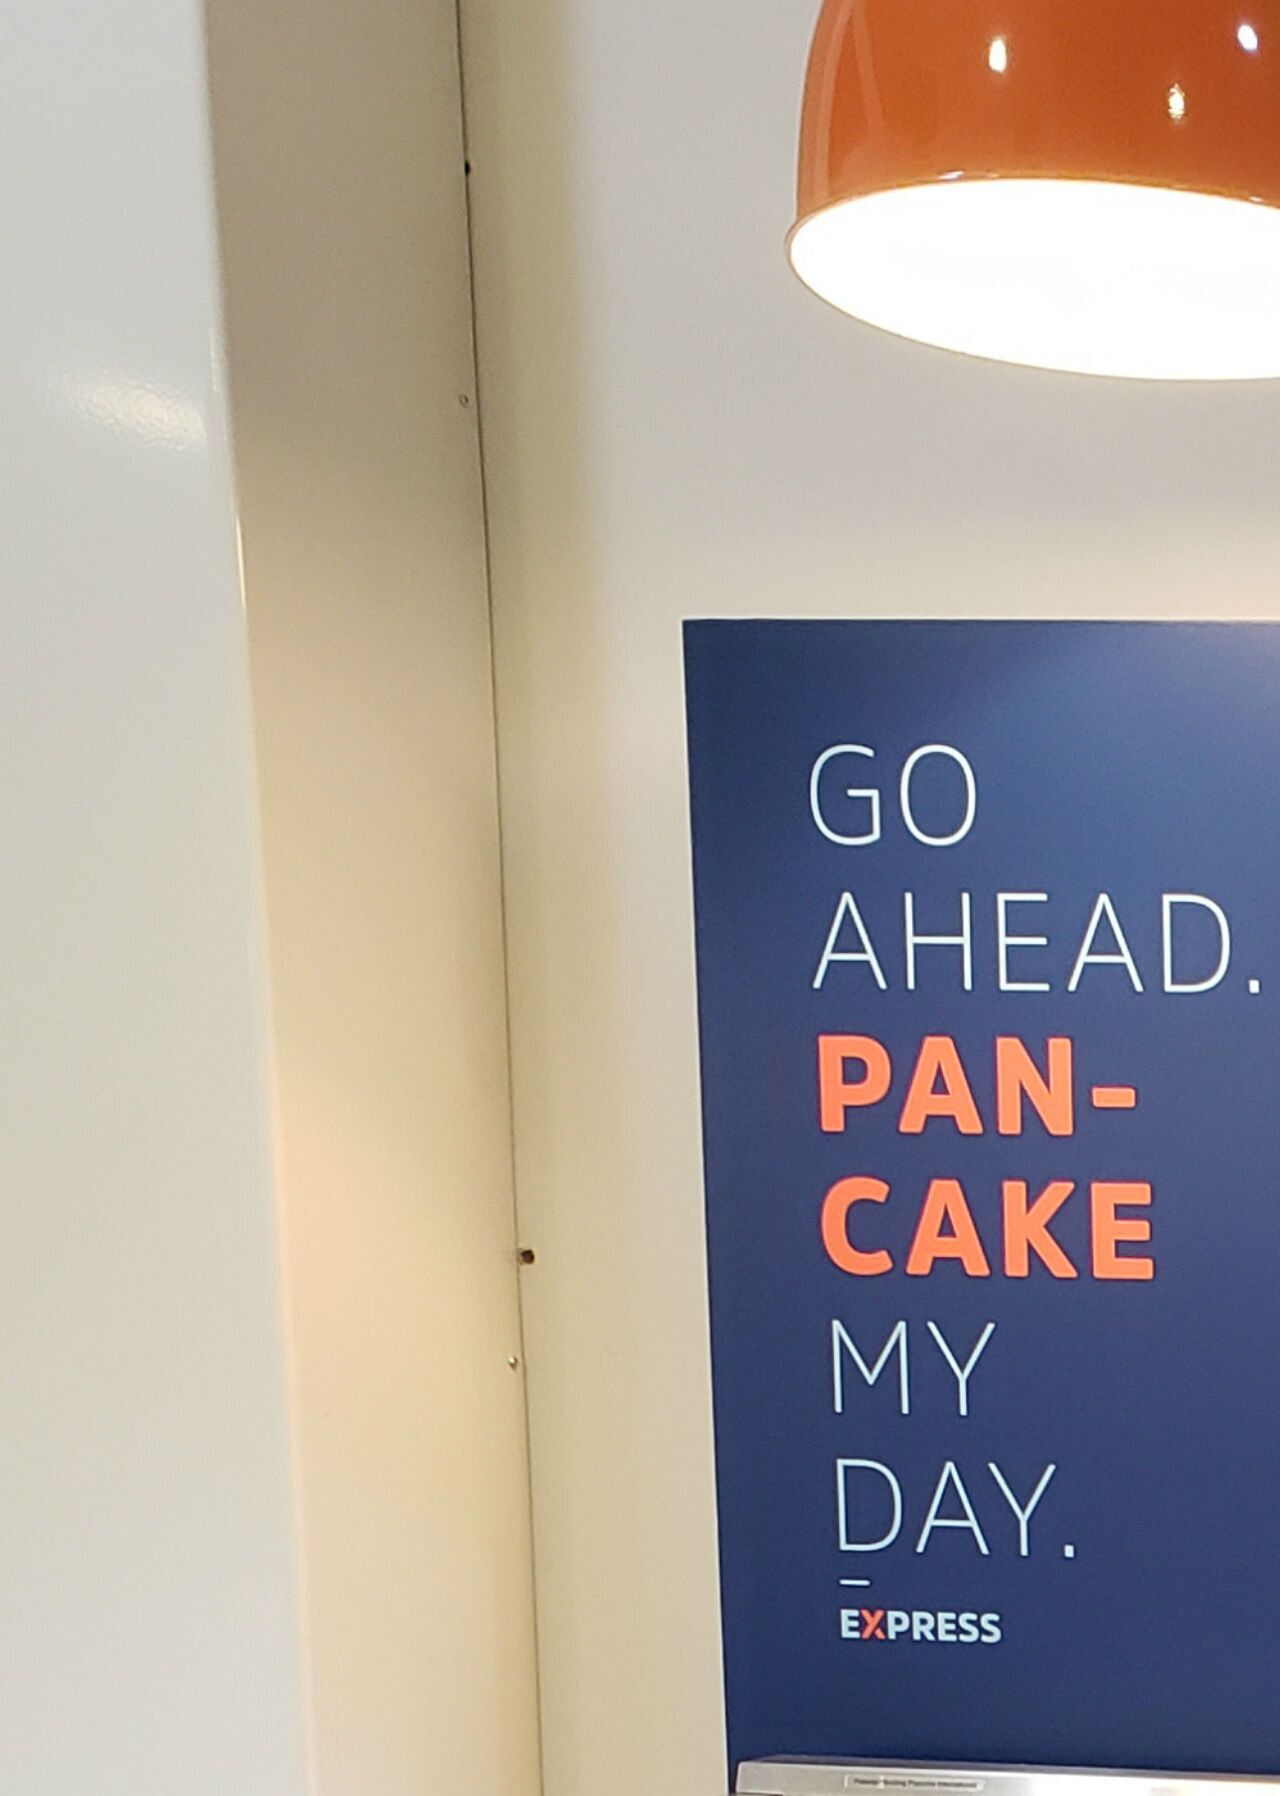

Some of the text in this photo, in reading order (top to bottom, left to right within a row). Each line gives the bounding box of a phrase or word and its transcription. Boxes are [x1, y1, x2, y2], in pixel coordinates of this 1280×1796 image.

[808, 743, 978, 846] GO
[812, 891, 1260, 995] AHEAD.
[817, 1034, 1137, 1137] PAN-
[820, 1175, 1155, 1281] CAKE
[830, 1318, 996, 1417] MY
[836, 1458, 1076, 1559] DAY.
[840, 1608, 1002, 1643] EXPRESS
